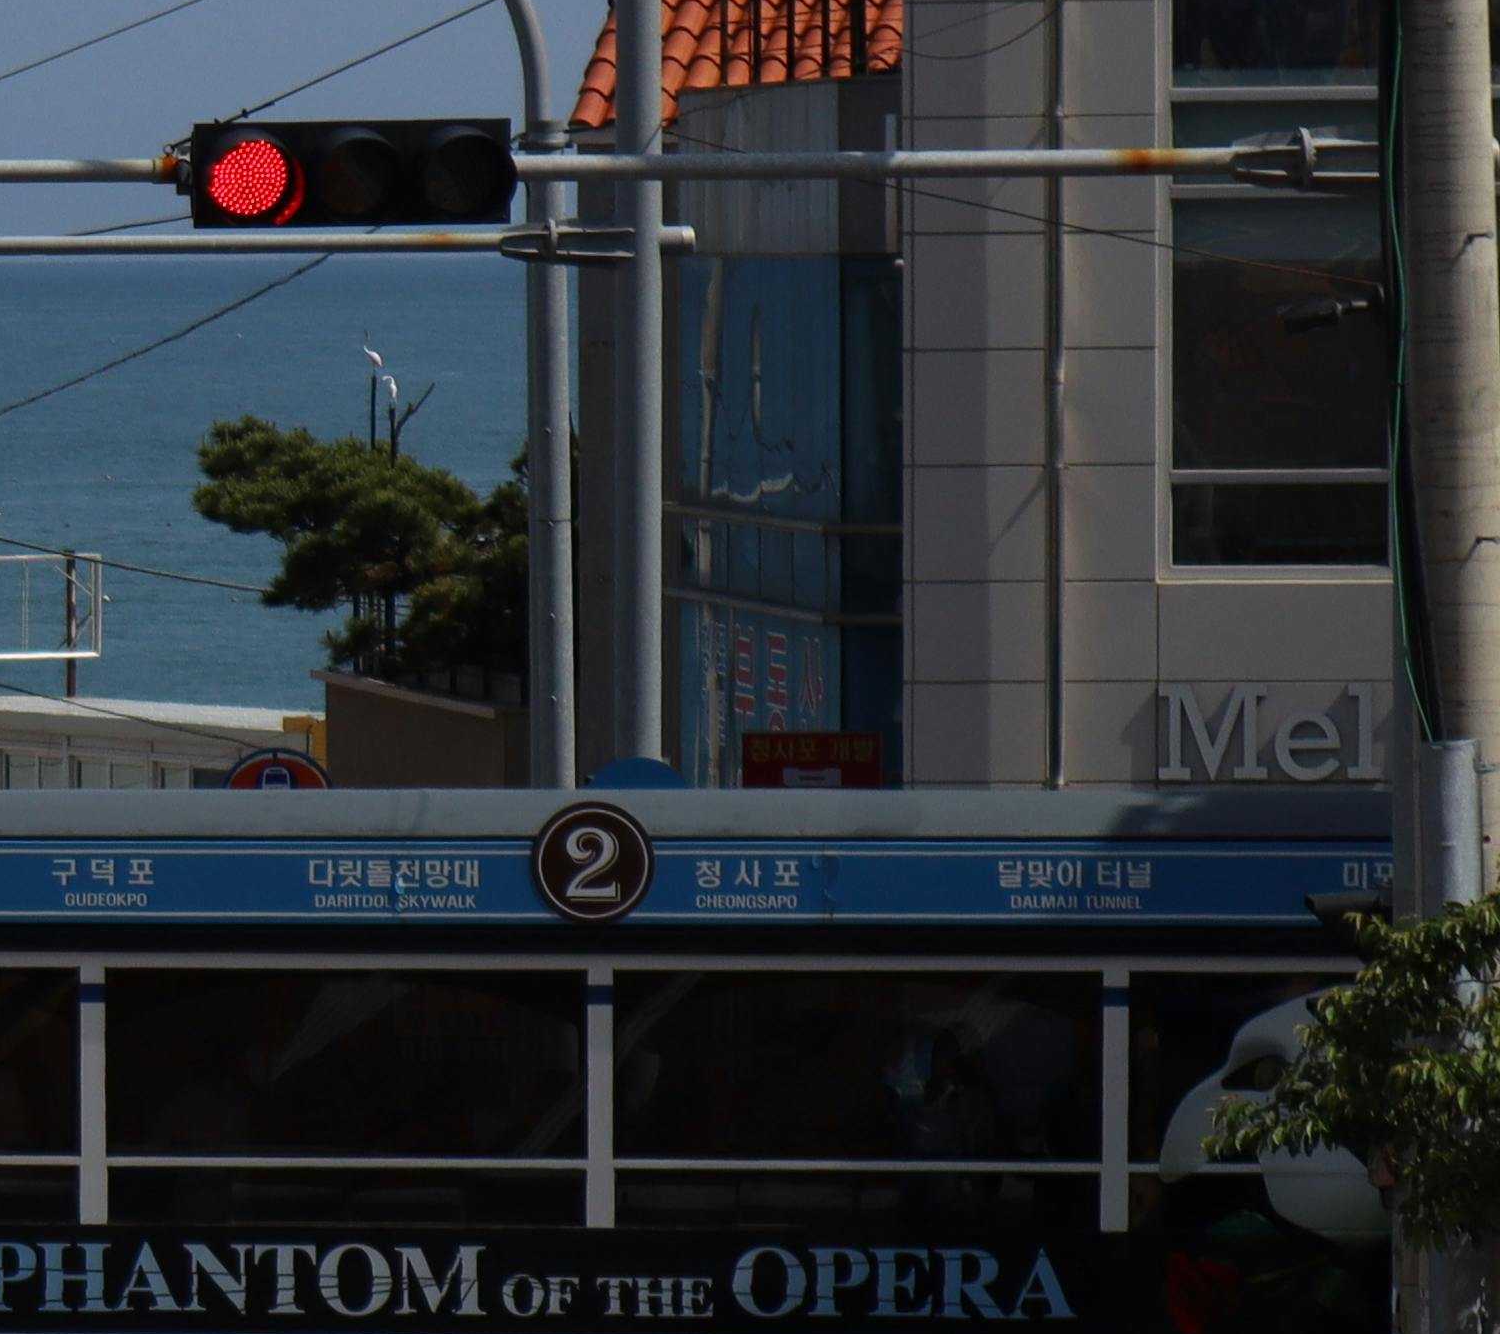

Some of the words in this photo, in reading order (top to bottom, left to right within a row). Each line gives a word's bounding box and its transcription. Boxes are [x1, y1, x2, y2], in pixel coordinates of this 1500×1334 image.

[51, 858, 155, 887] 구덕포
[309, 858, 480, 889] 다릿돌전망대
[564, 826, 622, 903] 2
[694, 859, 800, 889] 청사포
[998, 859, 1083, 889] 달맞이
[1096, 860, 1153, 889] 터널
[64, 893, 148, 908] GUDEOKPO
[314, 893, 391, 909] DARITDOL
[398, 893, 477, 910] SKYWALK
[695, 894, 798, 909] CHEONGSAPO
[1010, 894, 1078, 910] DALMAJI
[1085, 895, 1143, 910] TUNNEL
[501, 1273, 579, 1318] OF
[595, 1275, 715, 1319] THE
[731, 1245, 1077, 1321] OPERA
